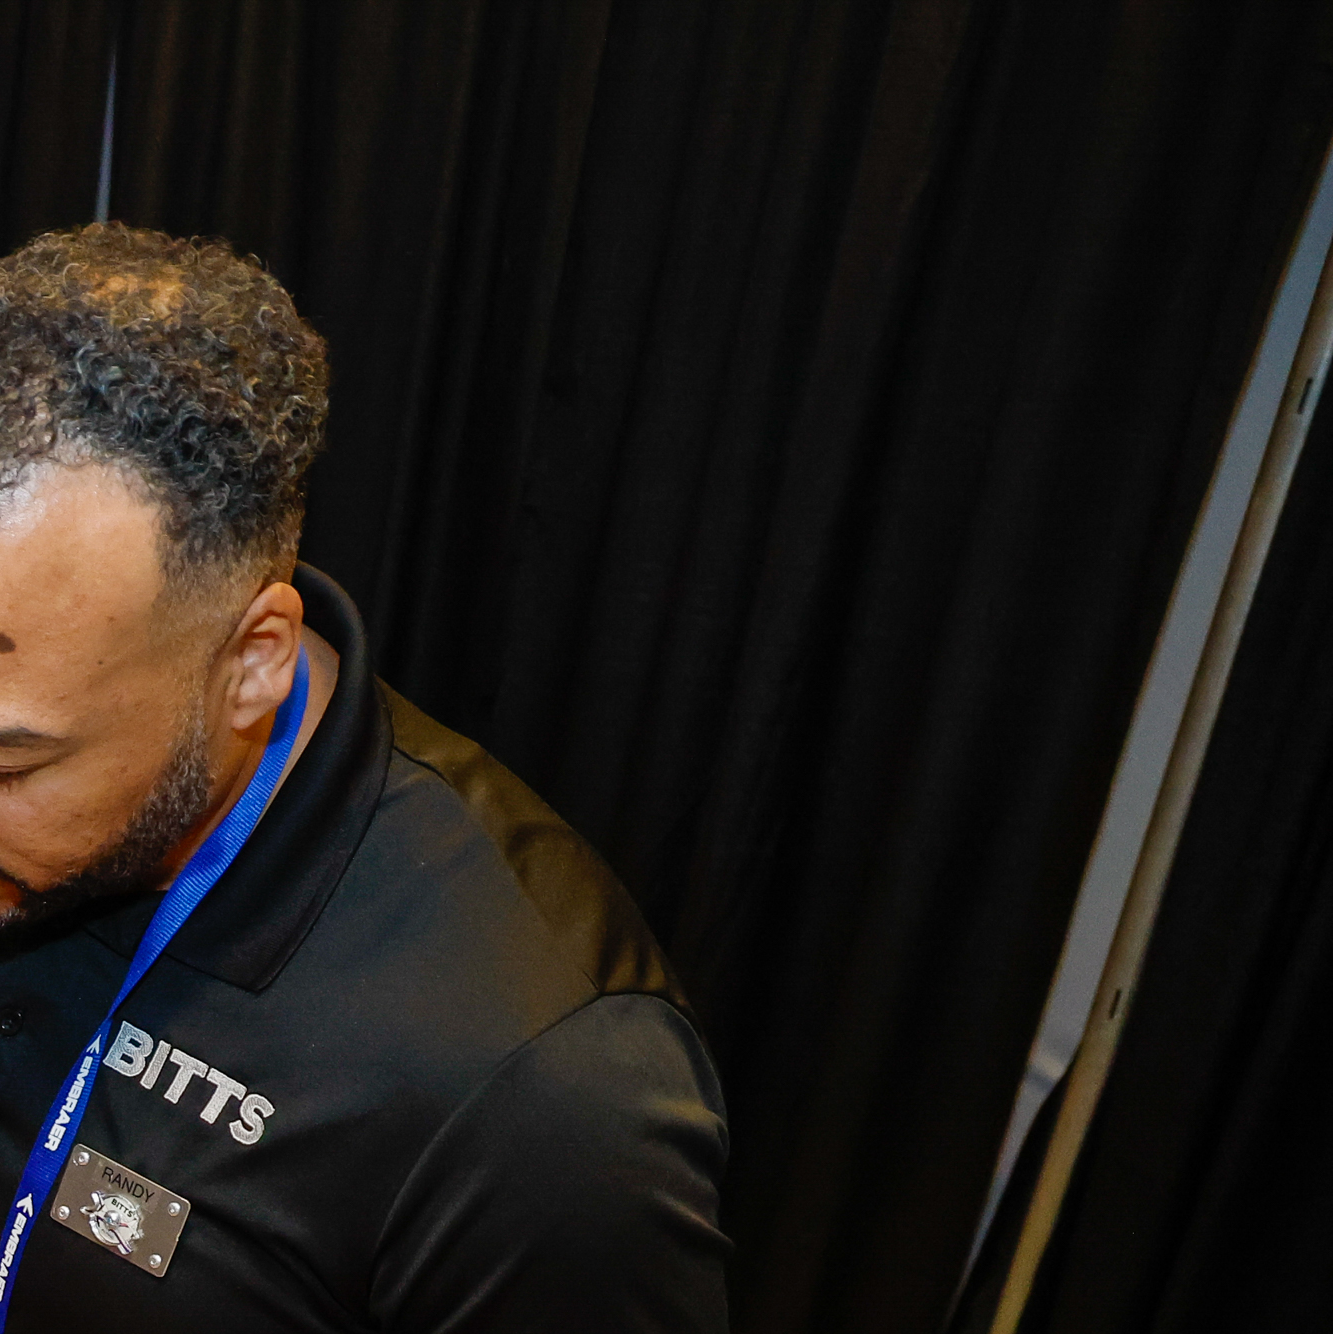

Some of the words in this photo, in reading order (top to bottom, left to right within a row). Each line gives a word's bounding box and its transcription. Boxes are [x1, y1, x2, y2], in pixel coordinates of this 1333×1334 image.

[44, 1056, 94, 1151] EMBRAER
[102, 1020, 275, 1145] BITTS
[101, 1166, 155, 1203] RANDY
[110, 1198, 134, 1218] BITTS
